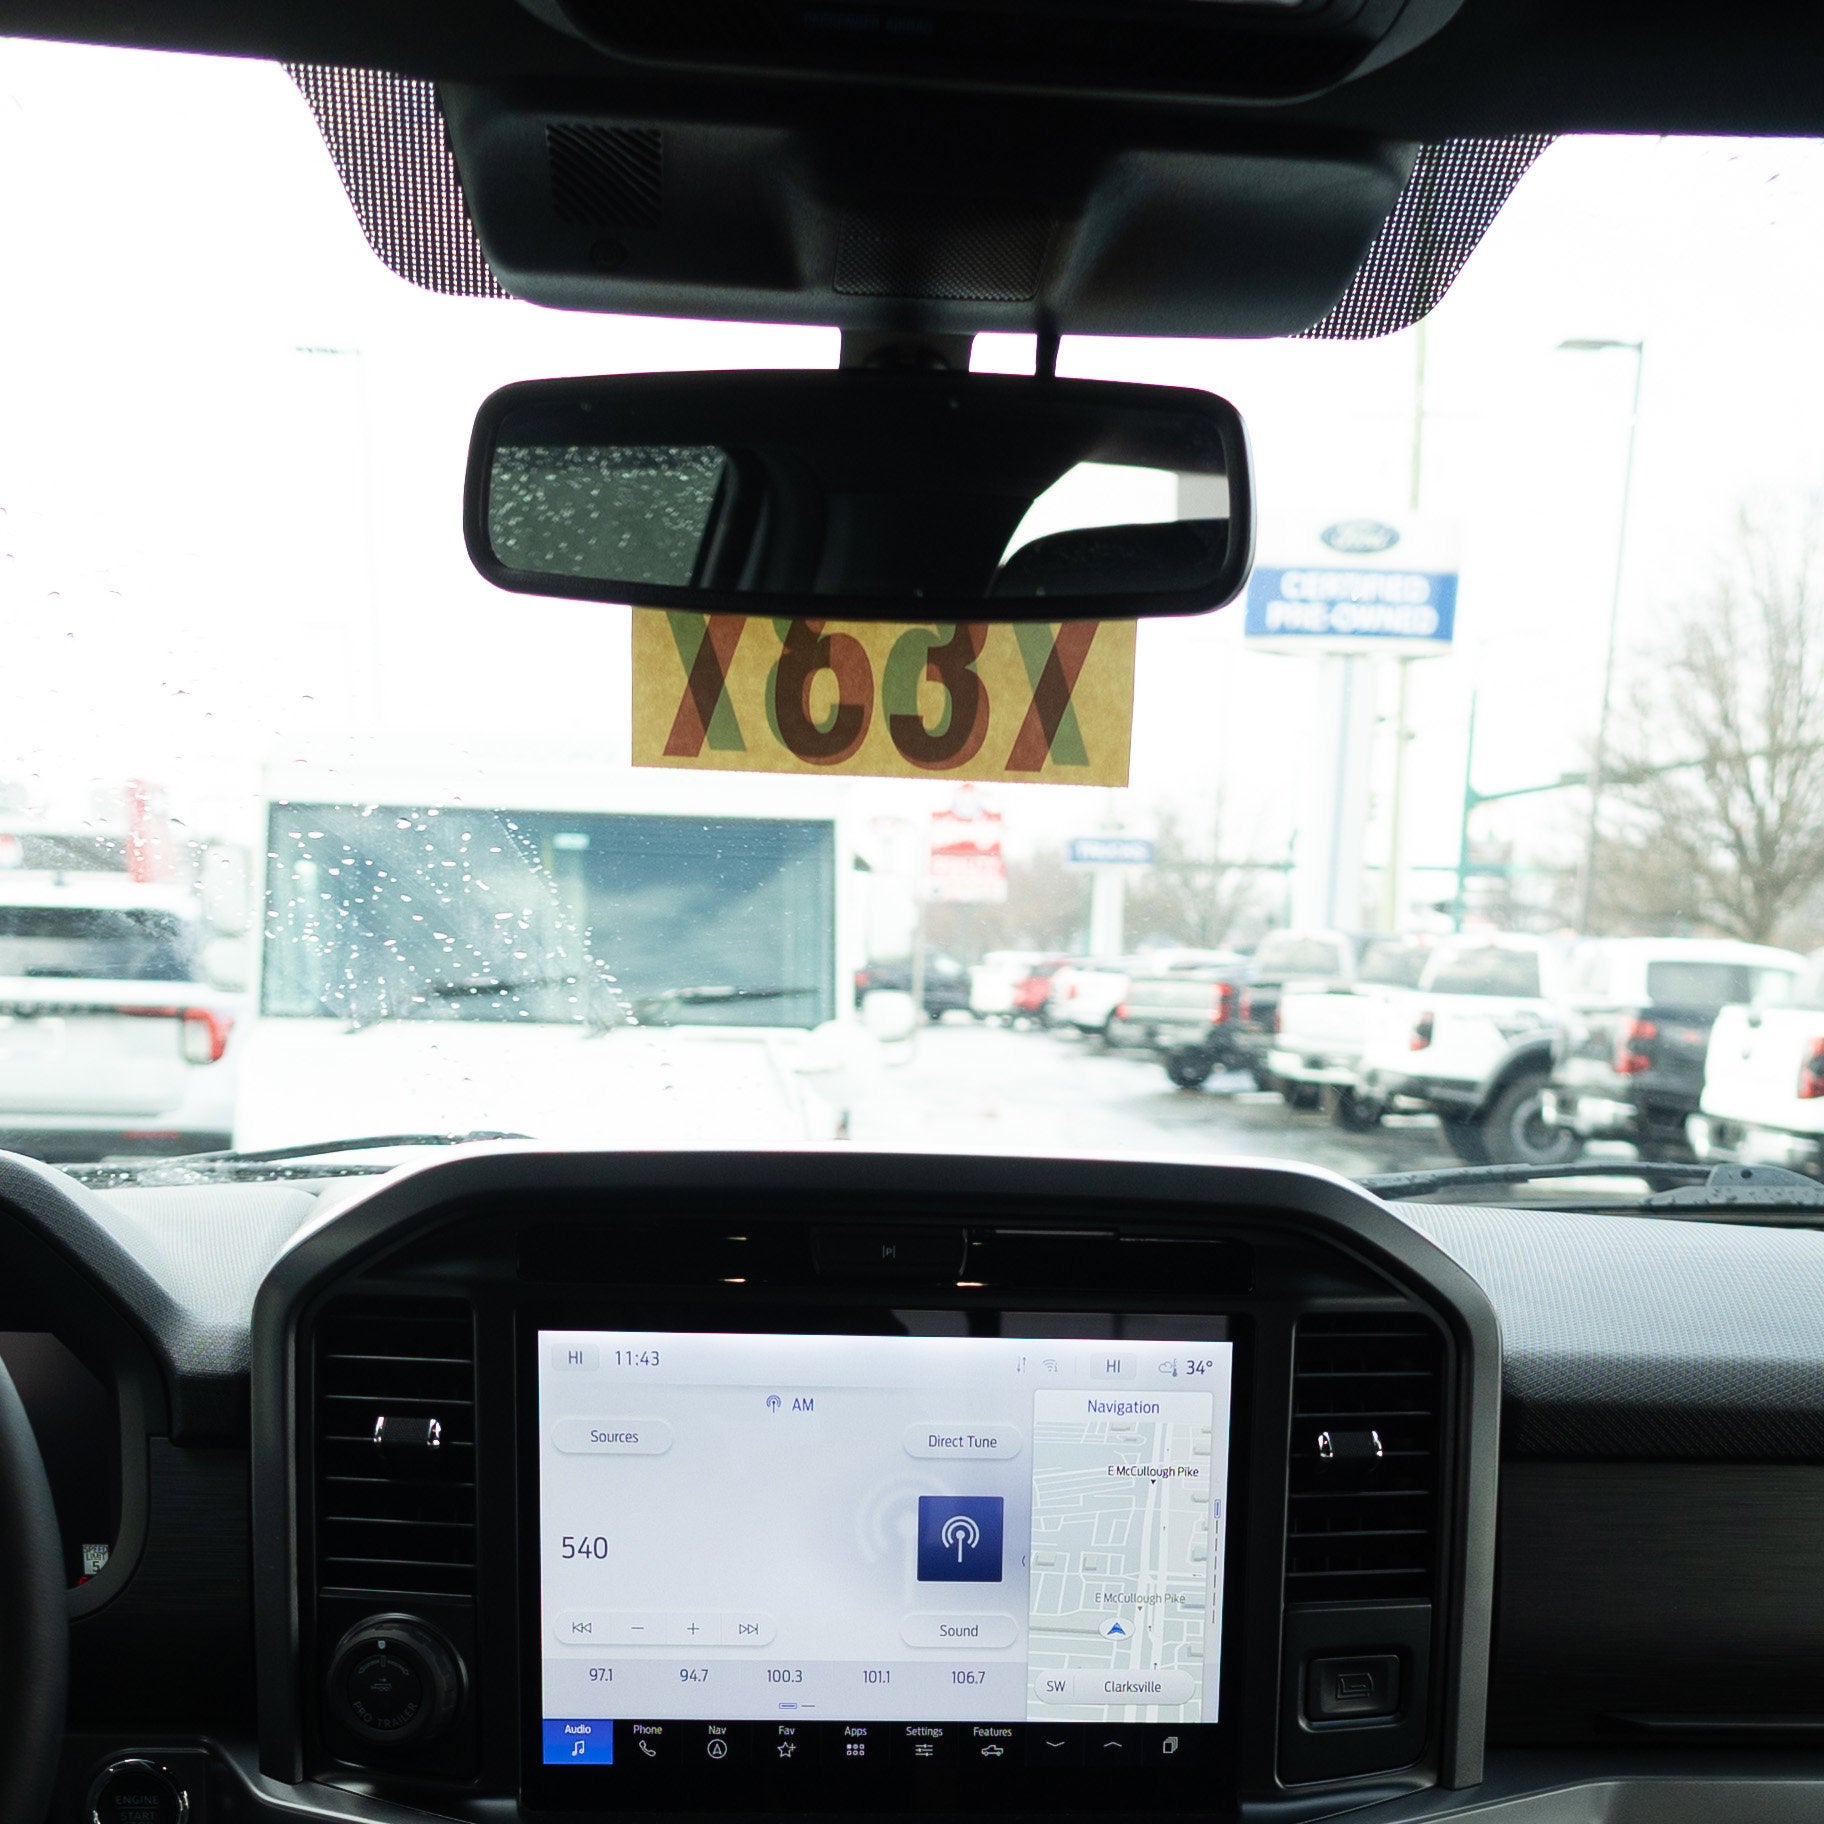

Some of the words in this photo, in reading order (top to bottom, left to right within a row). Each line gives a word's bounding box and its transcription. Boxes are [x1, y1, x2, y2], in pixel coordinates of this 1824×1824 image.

[1281, 571, 1430, 604] CERTIFIED
[1265, 601, 1439, 635] PRE-OWNED
[568, 1351, 583, 1365] HI
[614, 1350, 660, 1366] 11:43
[1106, 1360, 1121, 1374] HI
[1186, 1360, 1213, 1376] 34°
[791, 1398, 815, 1412] AM
[1087, 1399, 1160, 1417] Navigation
[590, 1429, 639, 1444] Sources
[928, 1434, 964, 1449] Direct
[968, 1435, 997, 1449] Tune
[1108, 1465, 1114, 1477] E
[1116, 1465, 1174, 1479] McCullough
[1177, 1465, 1199, 1478] Pike
[83, 1544, 108, 1553] SPEED
[561, 1536, 608, 1560] 540
[92, 1561, 101, 1573] 5
[1095, 1592, 1102, 1603] E
[1104, 1591, 1161, 1606] McCullough
[1165, 1592, 1186, 1604] Pike
[939, 1623, 979, 1639] Sound
[588, 1668, 613, 1682] 97.1
[679, 1668, 709, 1683] 94.7
[767, 1668, 803, 1684] 100.3
[862, 1670, 891, 1684] 101.1
[951, 1670, 986, 1684] 106.7
[1046, 1680, 1066, 1693] SW
[1104, 1678, 1161, 1694] Clarksville
[352, 1701, 372, 1723] PRO
[377, 1702, 418, 1728] TRAILER
[564, 1724, 591, 1736] Audio
[633, 1724, 663, 1736] Phone
[708, 1724, 727, 1736] Nav
[778, 1725, 795, 1736] Fav
[845, 1726, 867, 1738] Apps
[906, 1726, 943, 1739] Settings
[973, 1726, 1012, 1738] Features
[115, 1795, 160, 1805] ENGINE
[120, 1811, 155, 1820] START
